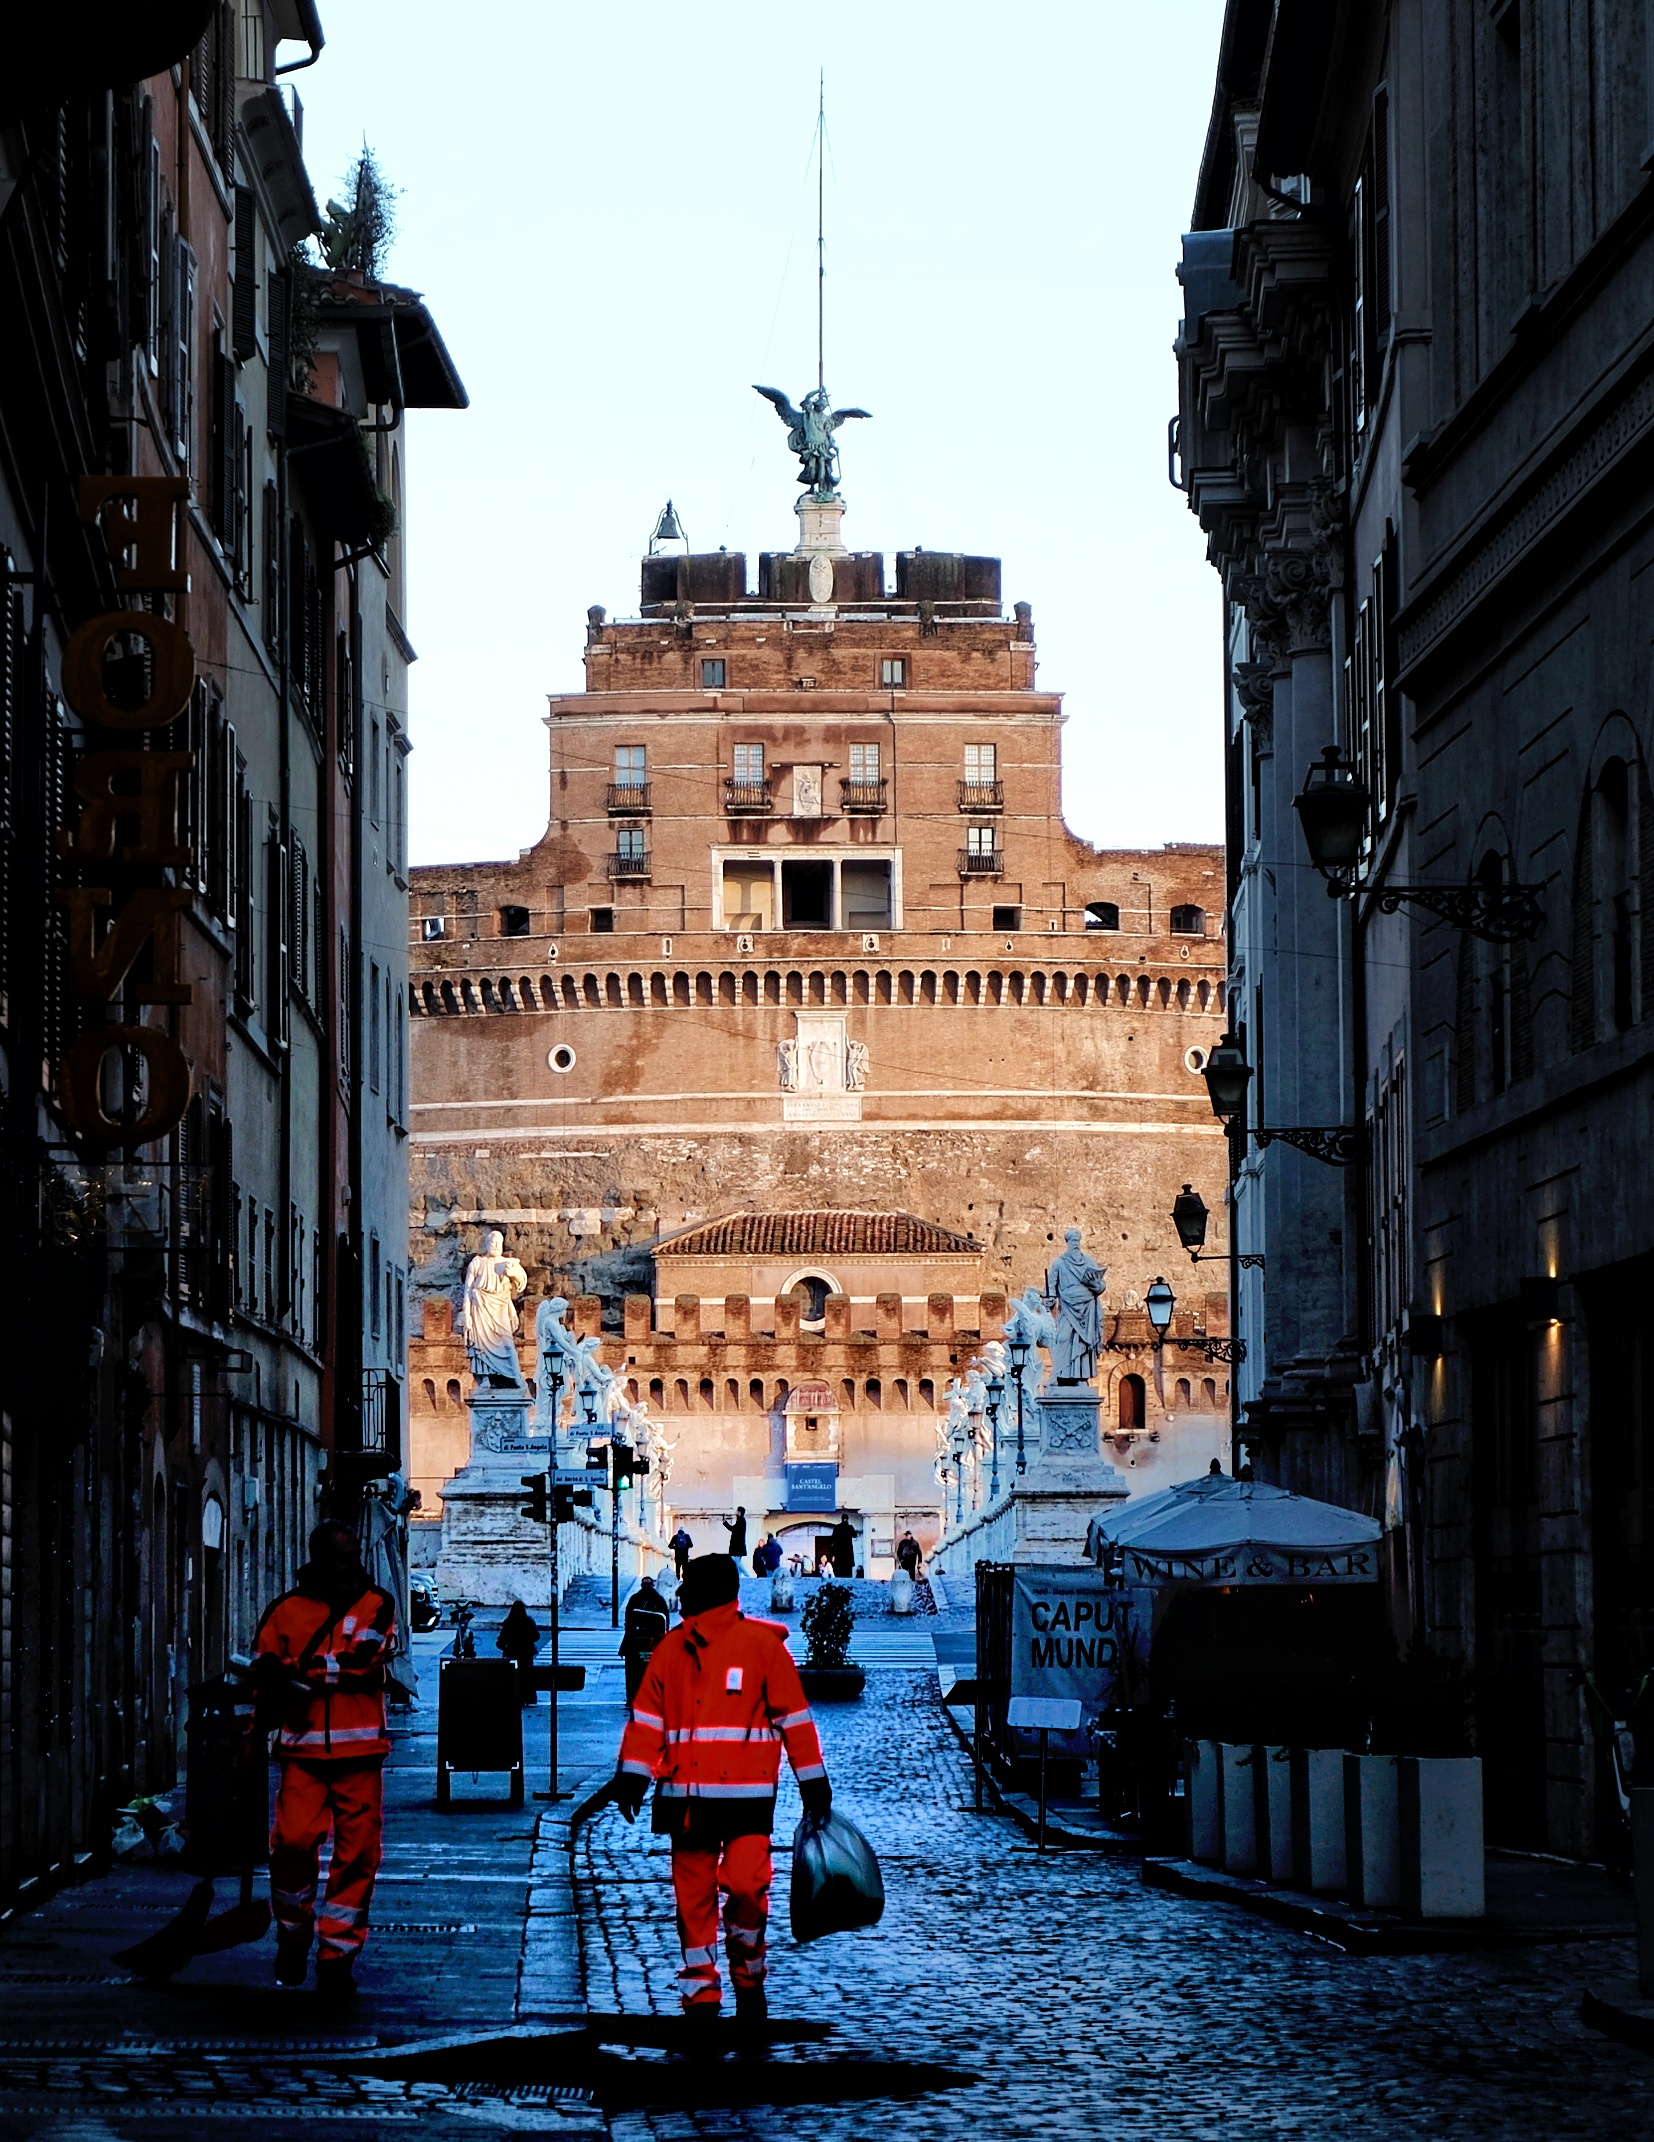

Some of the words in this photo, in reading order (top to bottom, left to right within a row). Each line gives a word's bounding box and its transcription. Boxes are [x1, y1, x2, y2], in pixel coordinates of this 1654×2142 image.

[1132, 1555, 1237, 1581] WINE
[1246, 1554, 1275, 1578] &
[1286, 1552, 1373, 1577] BAR
[1031, 1601, 1135, 1632] CAPUT
[1031, 1638, 1120, 1669] MUND
